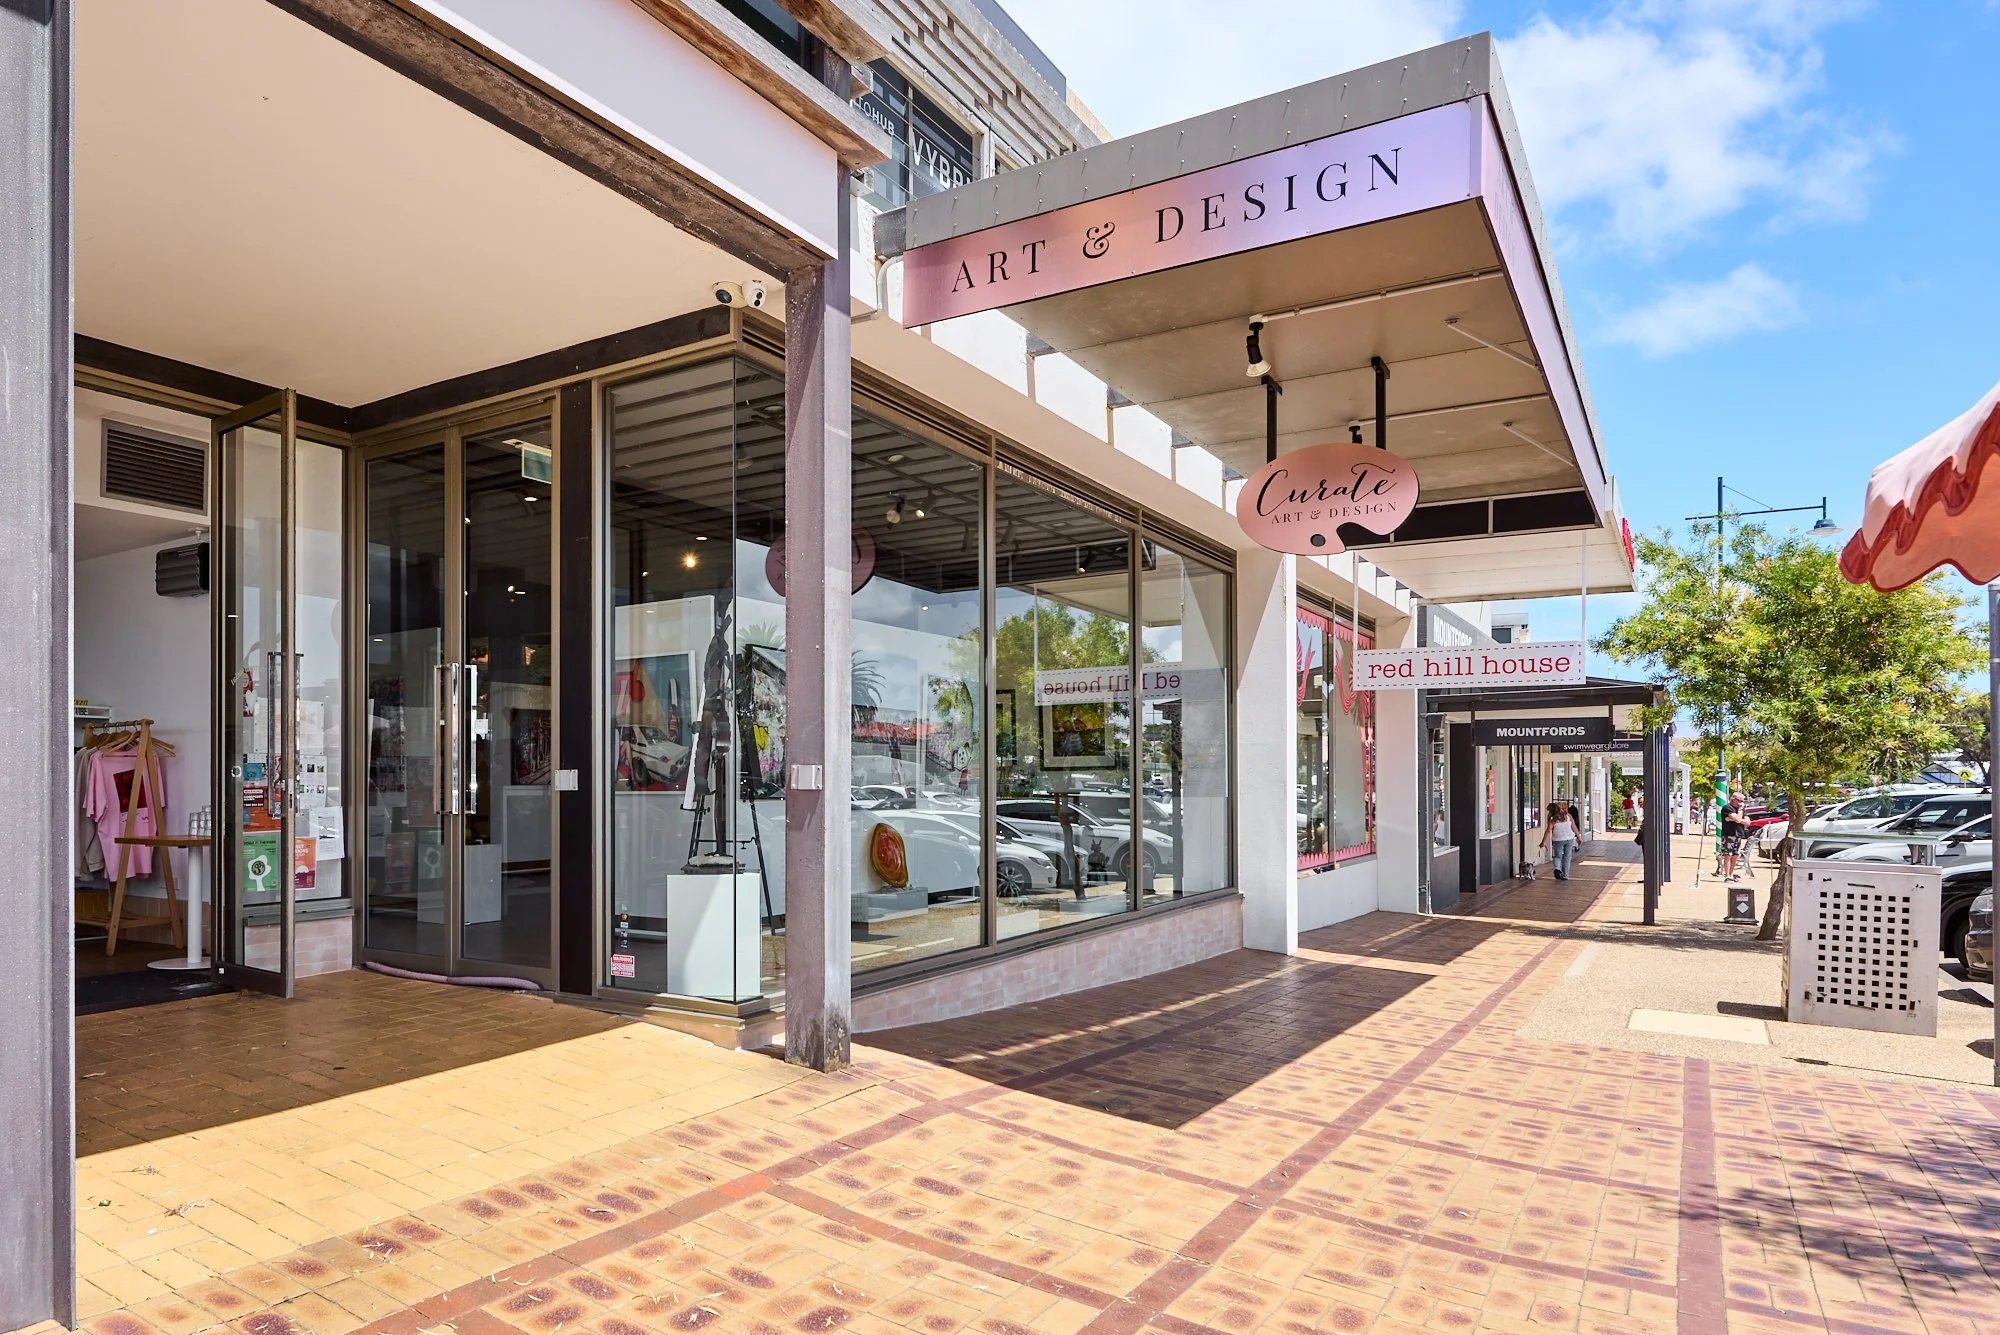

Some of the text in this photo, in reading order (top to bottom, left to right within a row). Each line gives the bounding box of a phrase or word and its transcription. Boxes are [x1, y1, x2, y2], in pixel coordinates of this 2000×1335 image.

[910, 130, 970, 190] VYBR
[951, 147, 1402, 294] ART & DESIGN
[1256, 462, 1398, 517] Curate
[1271, 501, 1397, 525] ART & DESIGN
[1368, 652, 1571, 679] red hill house
[1496, 726, 1586, 737] MOUNTFORDS
[1563, 741, 1630, 751] swimweargalore
